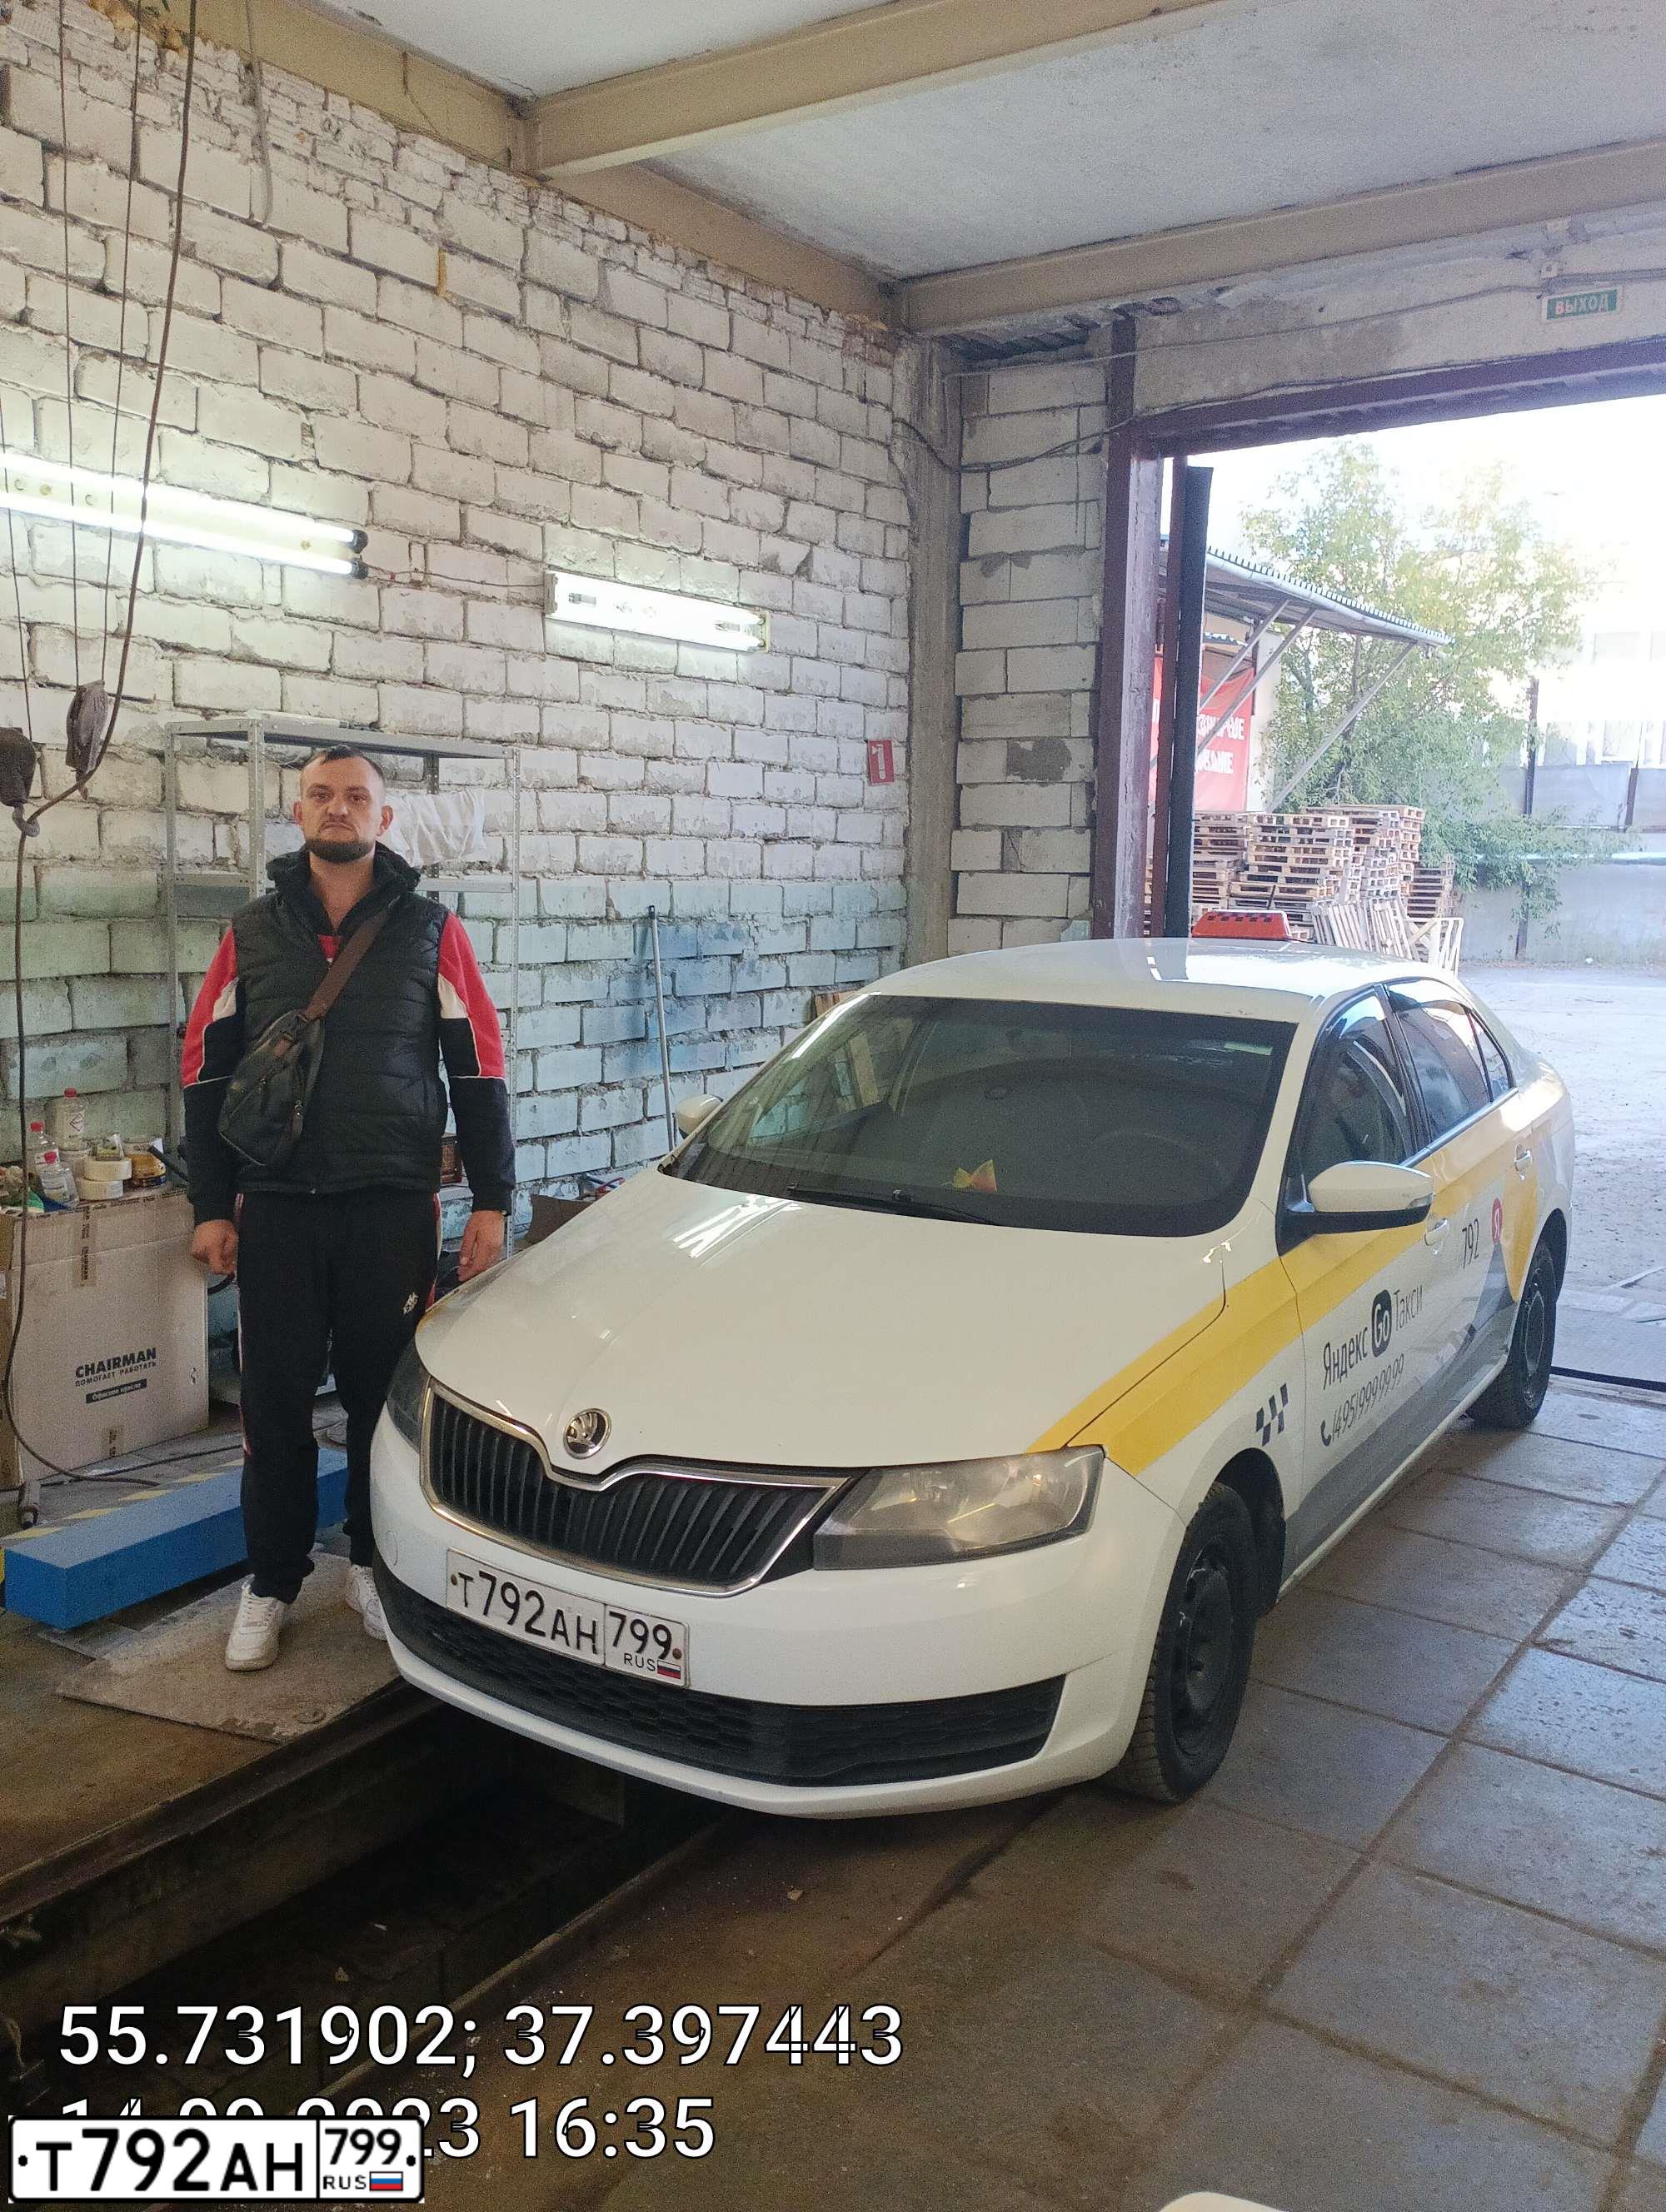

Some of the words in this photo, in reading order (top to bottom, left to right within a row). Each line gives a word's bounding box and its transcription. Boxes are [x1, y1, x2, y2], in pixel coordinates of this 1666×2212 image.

[1554, 292, 1609, 315] ВЫХОД
[1461, 1218, 1479, 1269] 792
[1323, 1326, 1368, 1390] Яндекс
[1374, 1302, 1391, 1349] Go
[1393, 1285, 1423, 1332] Такси
[75, 1347, 157, 1378] CHAIRMAN
[75, 1371, 116, 1387] ПОМОГАЕТ
[119, 1362, 157, 1376] РАБОТАТЬ
[608, 1611, 673, 1661] 799
[623, 1652, 656, 1672] RUS
